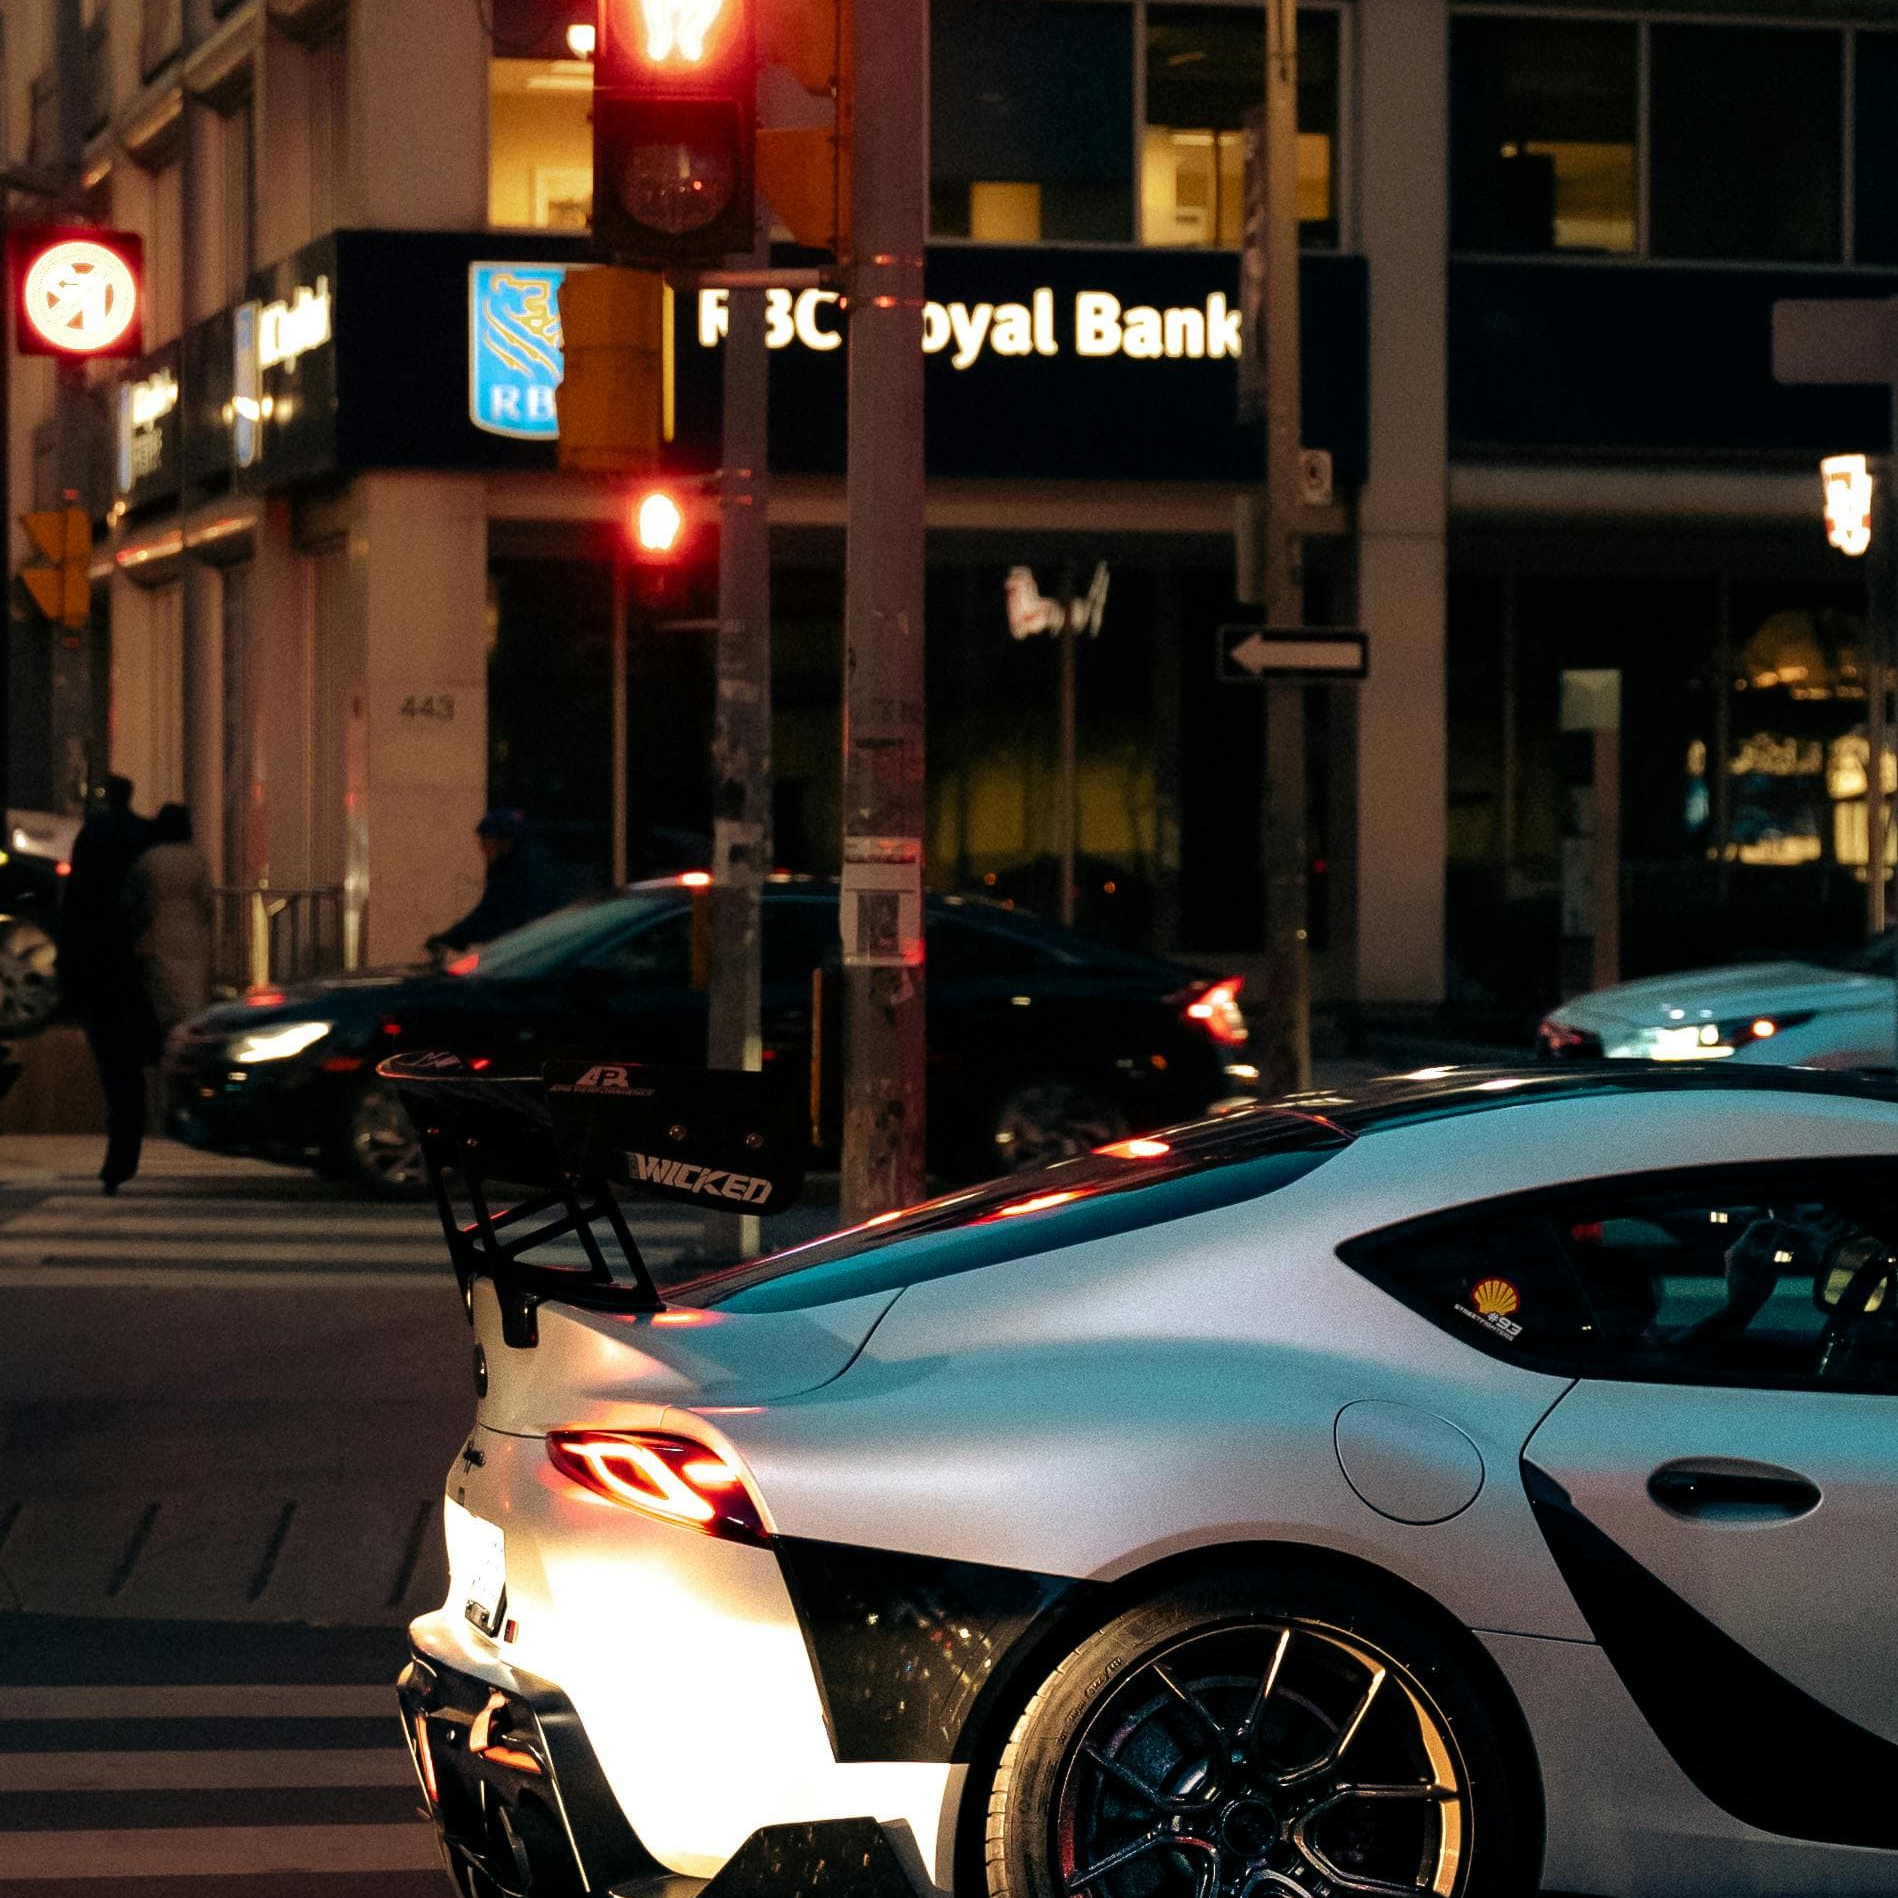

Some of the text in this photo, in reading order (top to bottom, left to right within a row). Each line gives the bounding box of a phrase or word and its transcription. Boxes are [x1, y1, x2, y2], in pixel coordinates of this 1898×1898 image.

[921, 287, 1059, 370] oyal
[1075, 290, 1243, 359] Bank
[490, 383, 558, 421] RB
[632, 1152, 774, 1204] WICKED
[1487, 1312, 1524, 1337] #93
